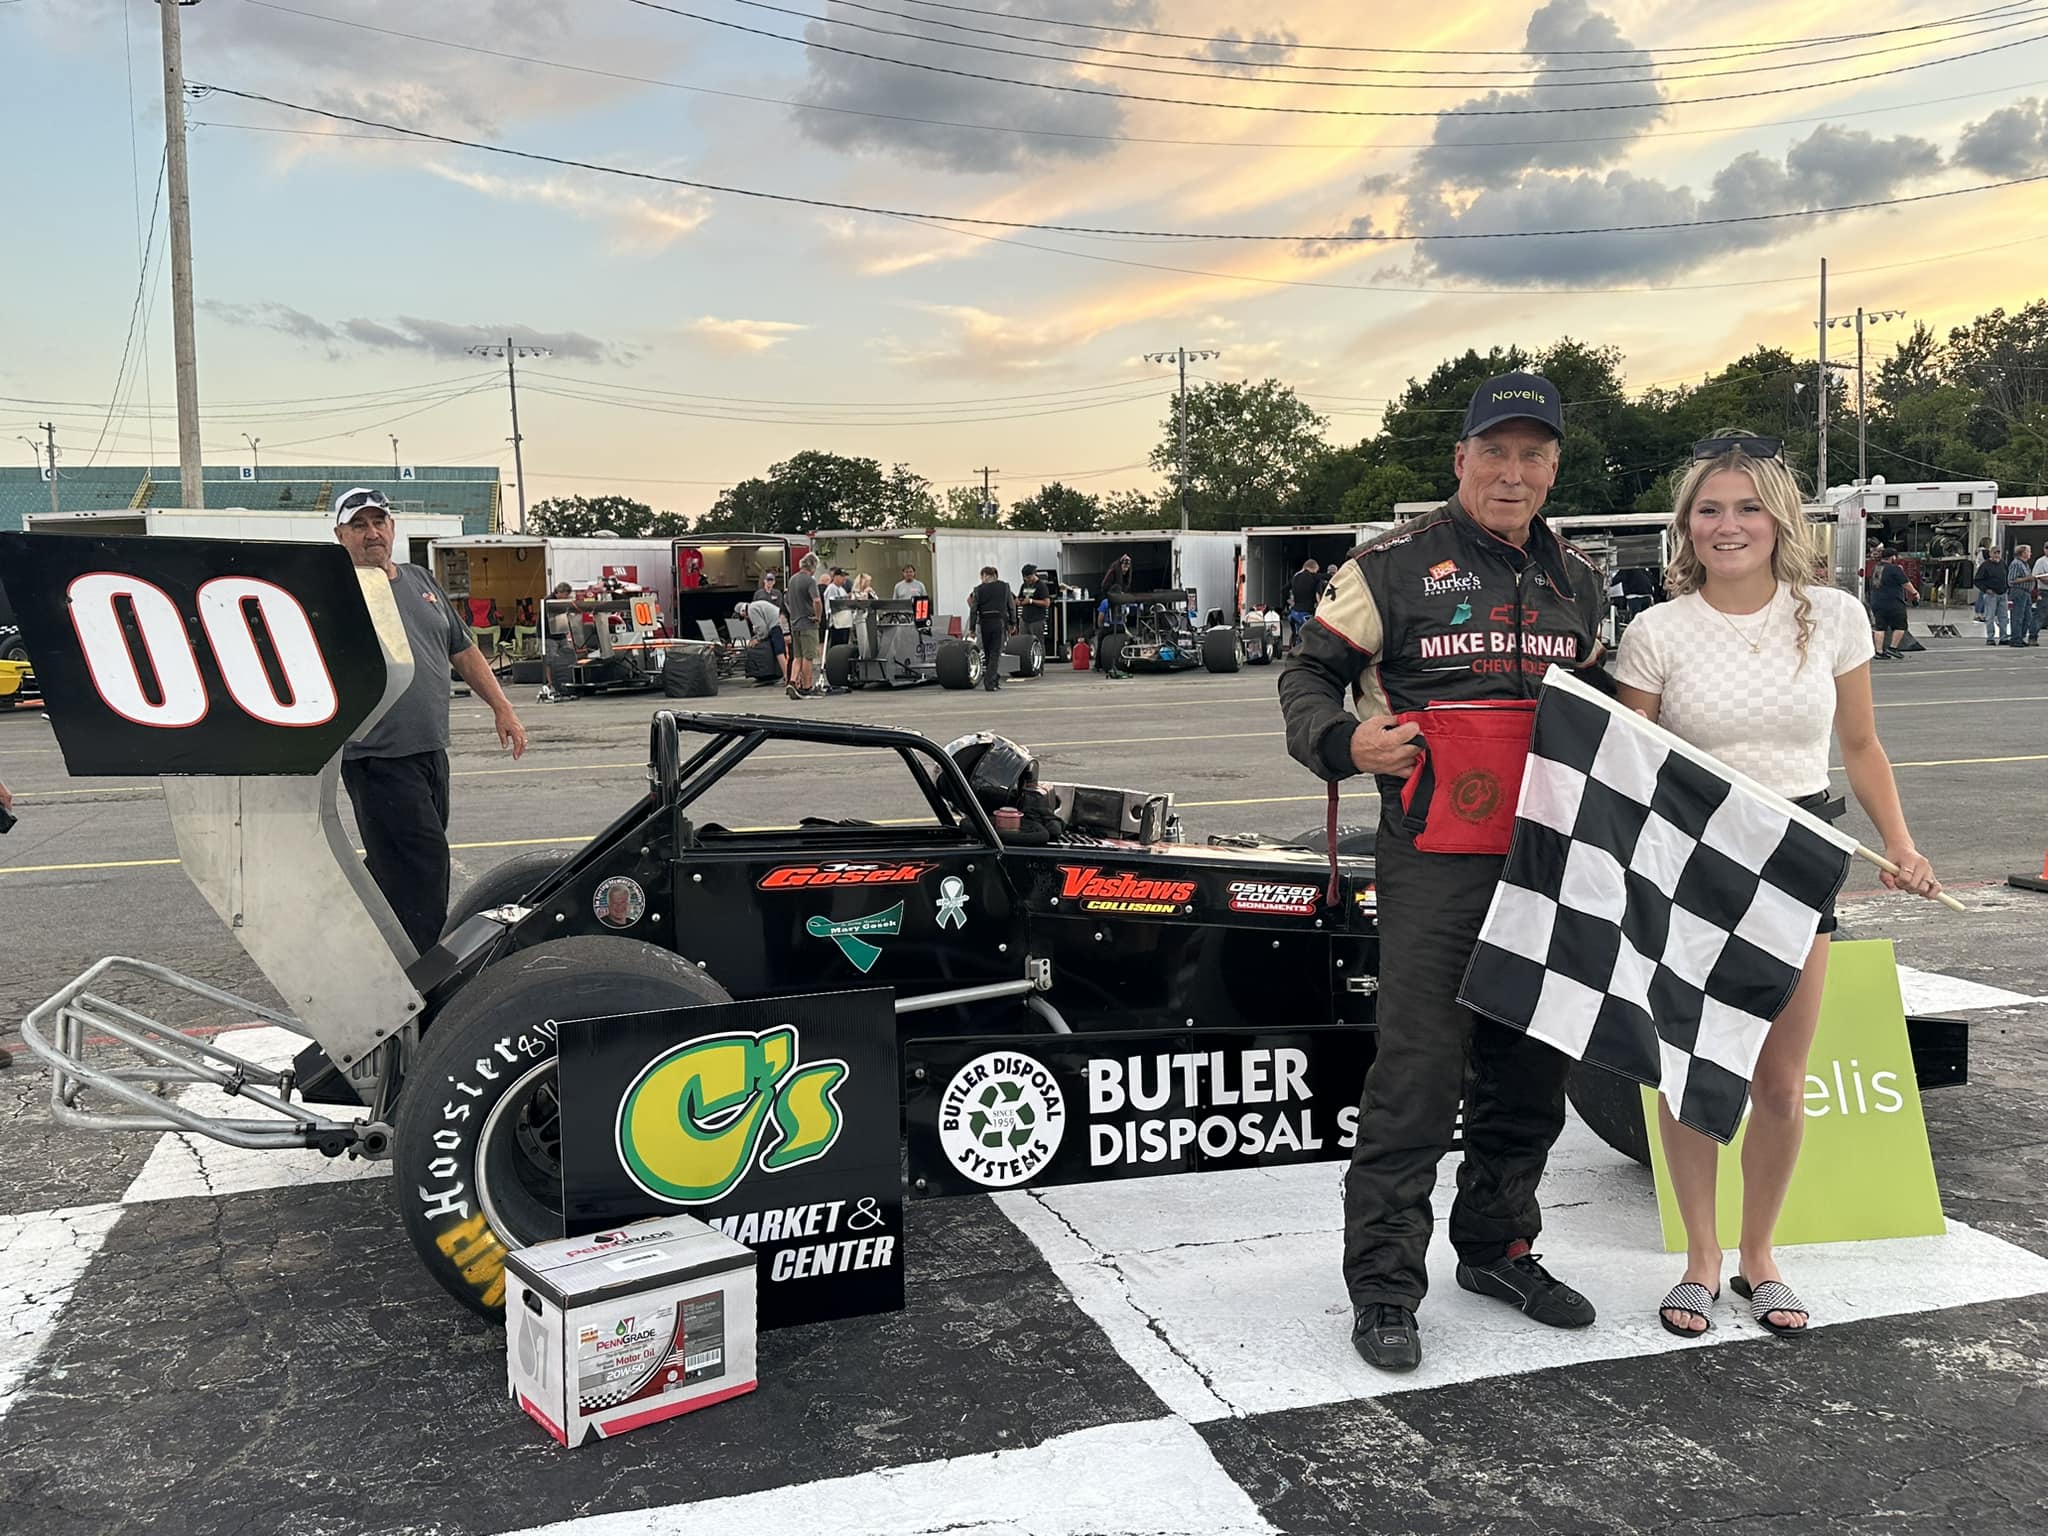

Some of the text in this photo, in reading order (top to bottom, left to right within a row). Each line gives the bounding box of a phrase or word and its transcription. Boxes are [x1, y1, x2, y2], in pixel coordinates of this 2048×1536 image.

[1492, 390, 1545, 404] Novelis
[243, 468, 251, 477] B
[404, 468, 412, 478] A
[1422, 572, 1481, 592] Burke's
[66, 571, 339, 729] 00
[1420, 632, 1486, 659] MIKE
[761, 865, 925, 887] Gosek
[1060, 866, 1195, 901] Vashaws
[1229, 882, 1317, 896] OSWEGO
[1235, 891, 1314, 905] COUNTY
[1087, 901, 1176, 913] COLLISION
[1236, 901, 1308, 912] MONUMENTS
[830, 926, 861, 934] Mary
[1088, 1048, 1314, 1114] BUTLER
[943, 1057, 1062, 1131] BUTLER DISPOSAL
[418, 1037, 518, 1219] Hoosier
[993, 1118, 1015, 1128] 1959
[1089, 1109, 1324, 1167] DISPOSAL
[958, 1139, 1049, 1179] SYSTEMS
[848, 1197, 886, 1231] &
[771, 1236, 895, 1282] CENTER
[616, 1354, 641, 1367] Motor
[643, 1348, 655, 1358] Oil
[606, 1363, 646, 1380] 20W-50
